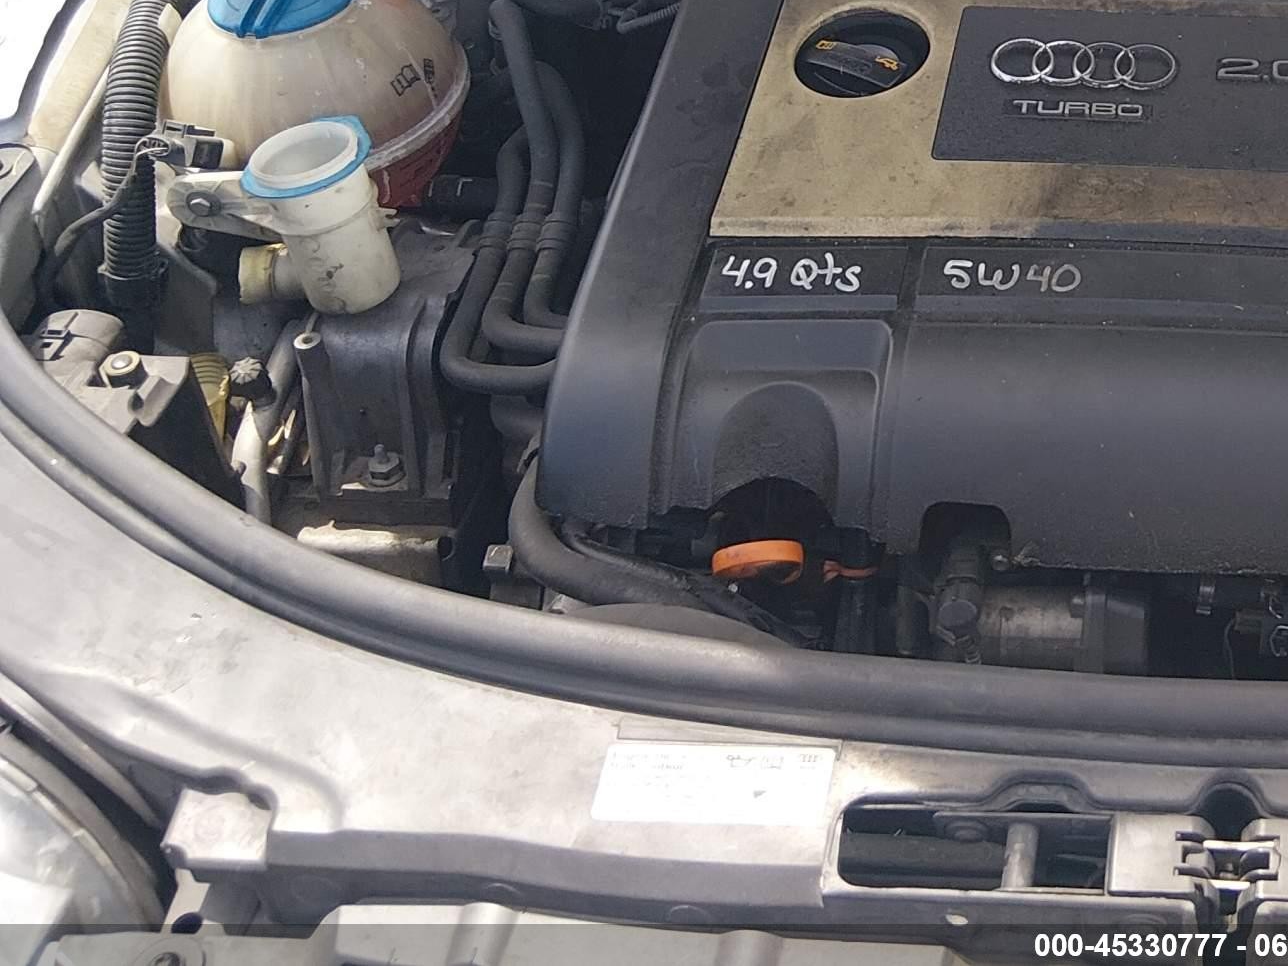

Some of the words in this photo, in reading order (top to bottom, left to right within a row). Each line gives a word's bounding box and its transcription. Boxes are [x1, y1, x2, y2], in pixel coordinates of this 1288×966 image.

[1013, 100, 1144, 117] TURBO
[722, 255, 777, 288] 4.9
[790, 253, 861, 292] Qts
